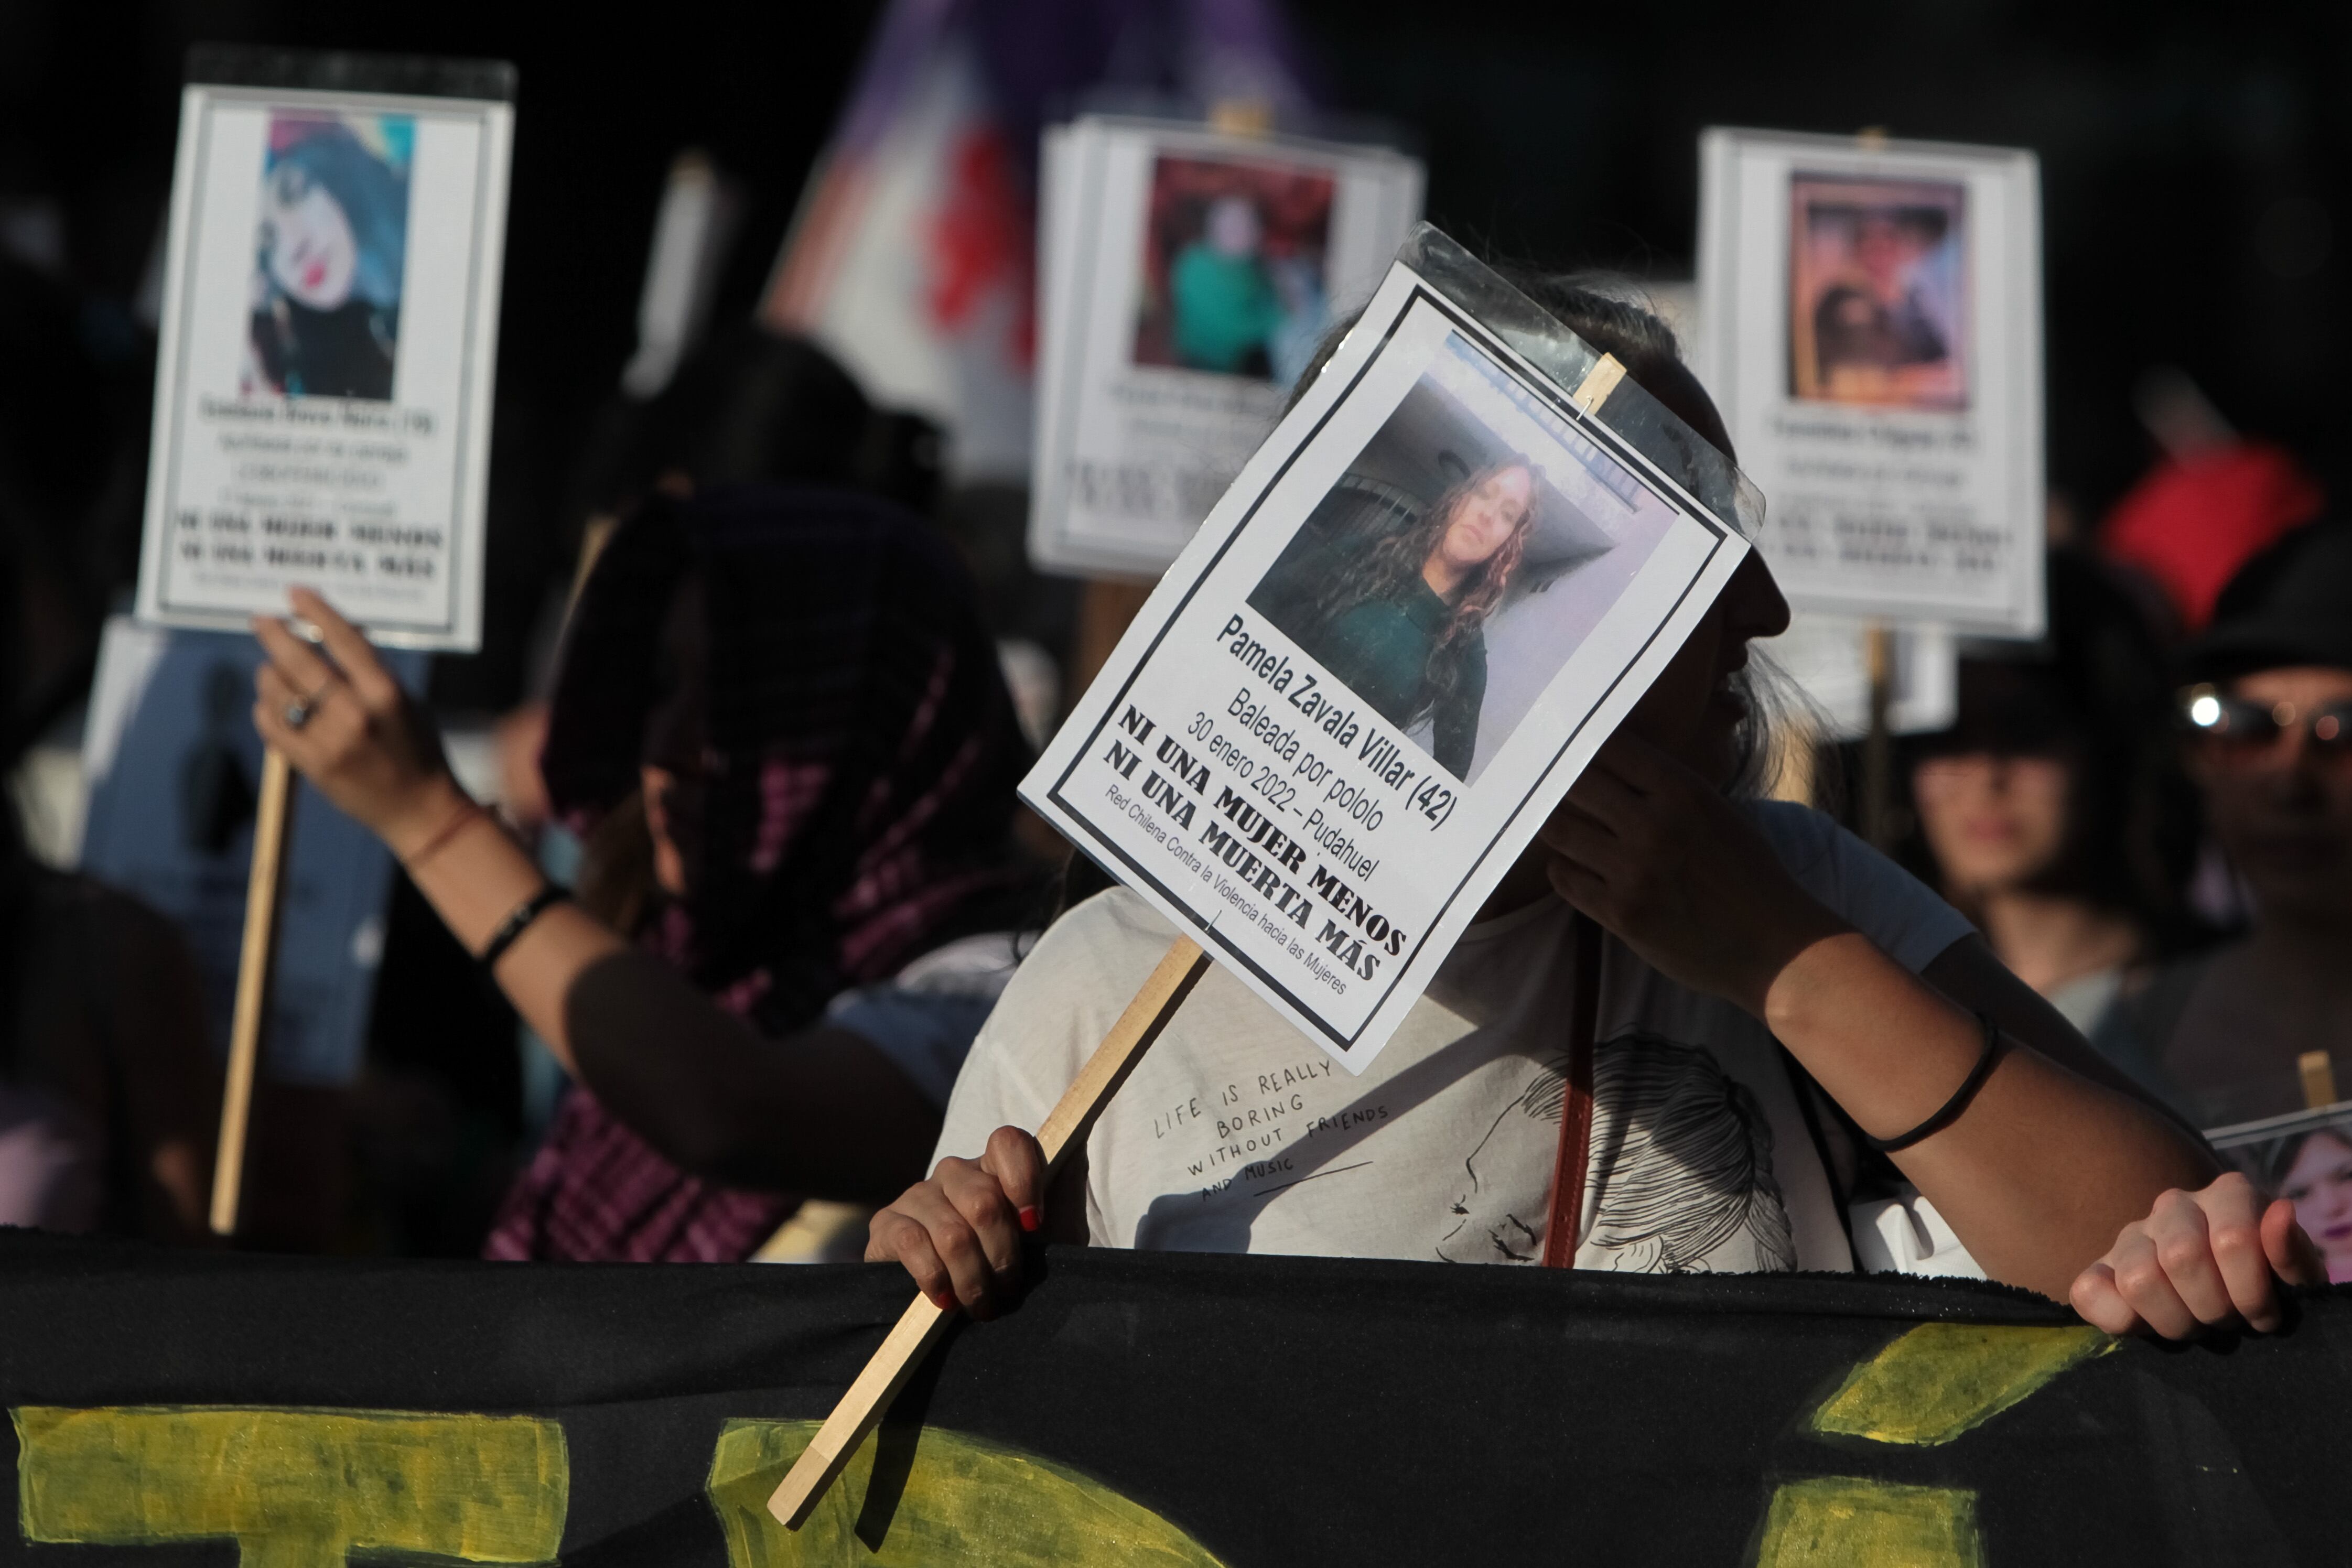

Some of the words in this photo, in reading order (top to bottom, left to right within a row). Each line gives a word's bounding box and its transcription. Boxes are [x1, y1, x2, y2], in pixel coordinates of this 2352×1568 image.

[1188, 712, 1214, 741] 30
[1209, 734, 1254, 778] enero
[1250, 766, 1296, 813] 2022
[1302, 808, 1379, 882] Pudahuel
[1216, 613, 1293, 694] Pamela
[1288, 674, 1359, 749] Zavala
[1358, 728, 1415, 791] Villar
[1405, 775, 1457, 831] (42)
[1227, 687, 1300, 763] Baleada
[1292, 752, 1333, 787] por
[1323, 778, 1383, 831] pololo
[1103, 739, 1142, 781] NI
[1141, 770, 1196, 831] UNA
[1198, 820, 1313, 929] MUERTA
[1315, 918, 1380, 981] MÁS
[1105, 784, 1131, 810] Red
[1128, 804, 1167, 844] Chilena
[1167, 837, 1202, 873] Contra
[1200, 865, 1213, 882] la
[1213, 874, 1259, 922] Violencia
[1257, 913, 1288, 946] hacia
[1287, 937, 1304, 959] las
[1303, 952, 1346, 994] Mujeres
[1118, 704, 1157, 745] NI
[1156, 734, 1211, 796] UNA
[1213, 785, 1307, 875] MUJER
[1307, 864, 1407, 956] MENOS
[1155, 1097, 1201, 1139] LIFE
[1222, 1085, 1238, 1106] IS
[1258, 1060, 1331, 1095] REALLY
[1187, 1128, 1282, 1176] WITHOUT
[1306, 1105, 1388, 1138] FRIENDS
[1216, 1094, 1303, 1139] BORING
[1202, 1177, 1232, 1202] AND
[1244, 1158, 1293, 1181] MUSIC
